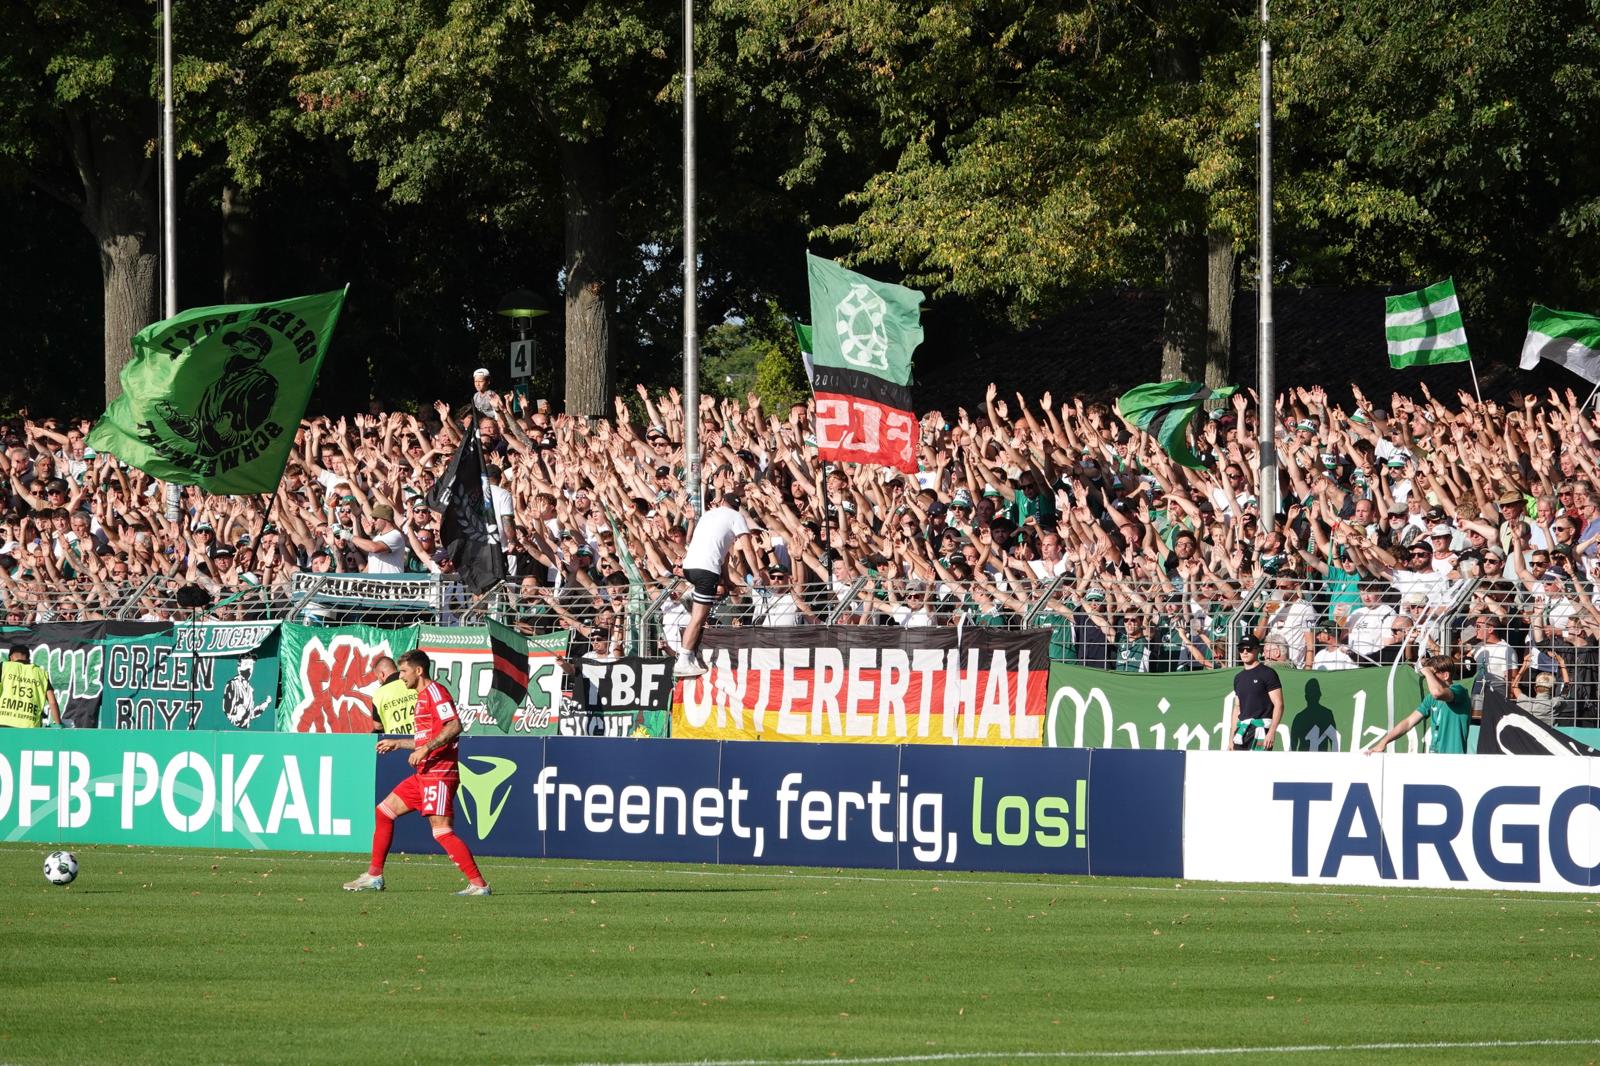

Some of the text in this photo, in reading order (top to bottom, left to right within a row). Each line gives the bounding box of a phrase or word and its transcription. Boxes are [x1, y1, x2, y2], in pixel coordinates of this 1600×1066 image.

[514, 344, 528, 372] 4
[176, 627, 207, 651] FCS
[8, 673, 41, 688] STEWARD
[108, 644, 215, 692] GREEN
[582, 663, 666, 707] T.B.F.
[12, 685, 34, 699] 153
[682, 647, 1042, 740] UNTERERTHAL
[534, 766, 1087, 864] freenet, fertig, los!
[1272, 781, 1600, 887] TARGO
